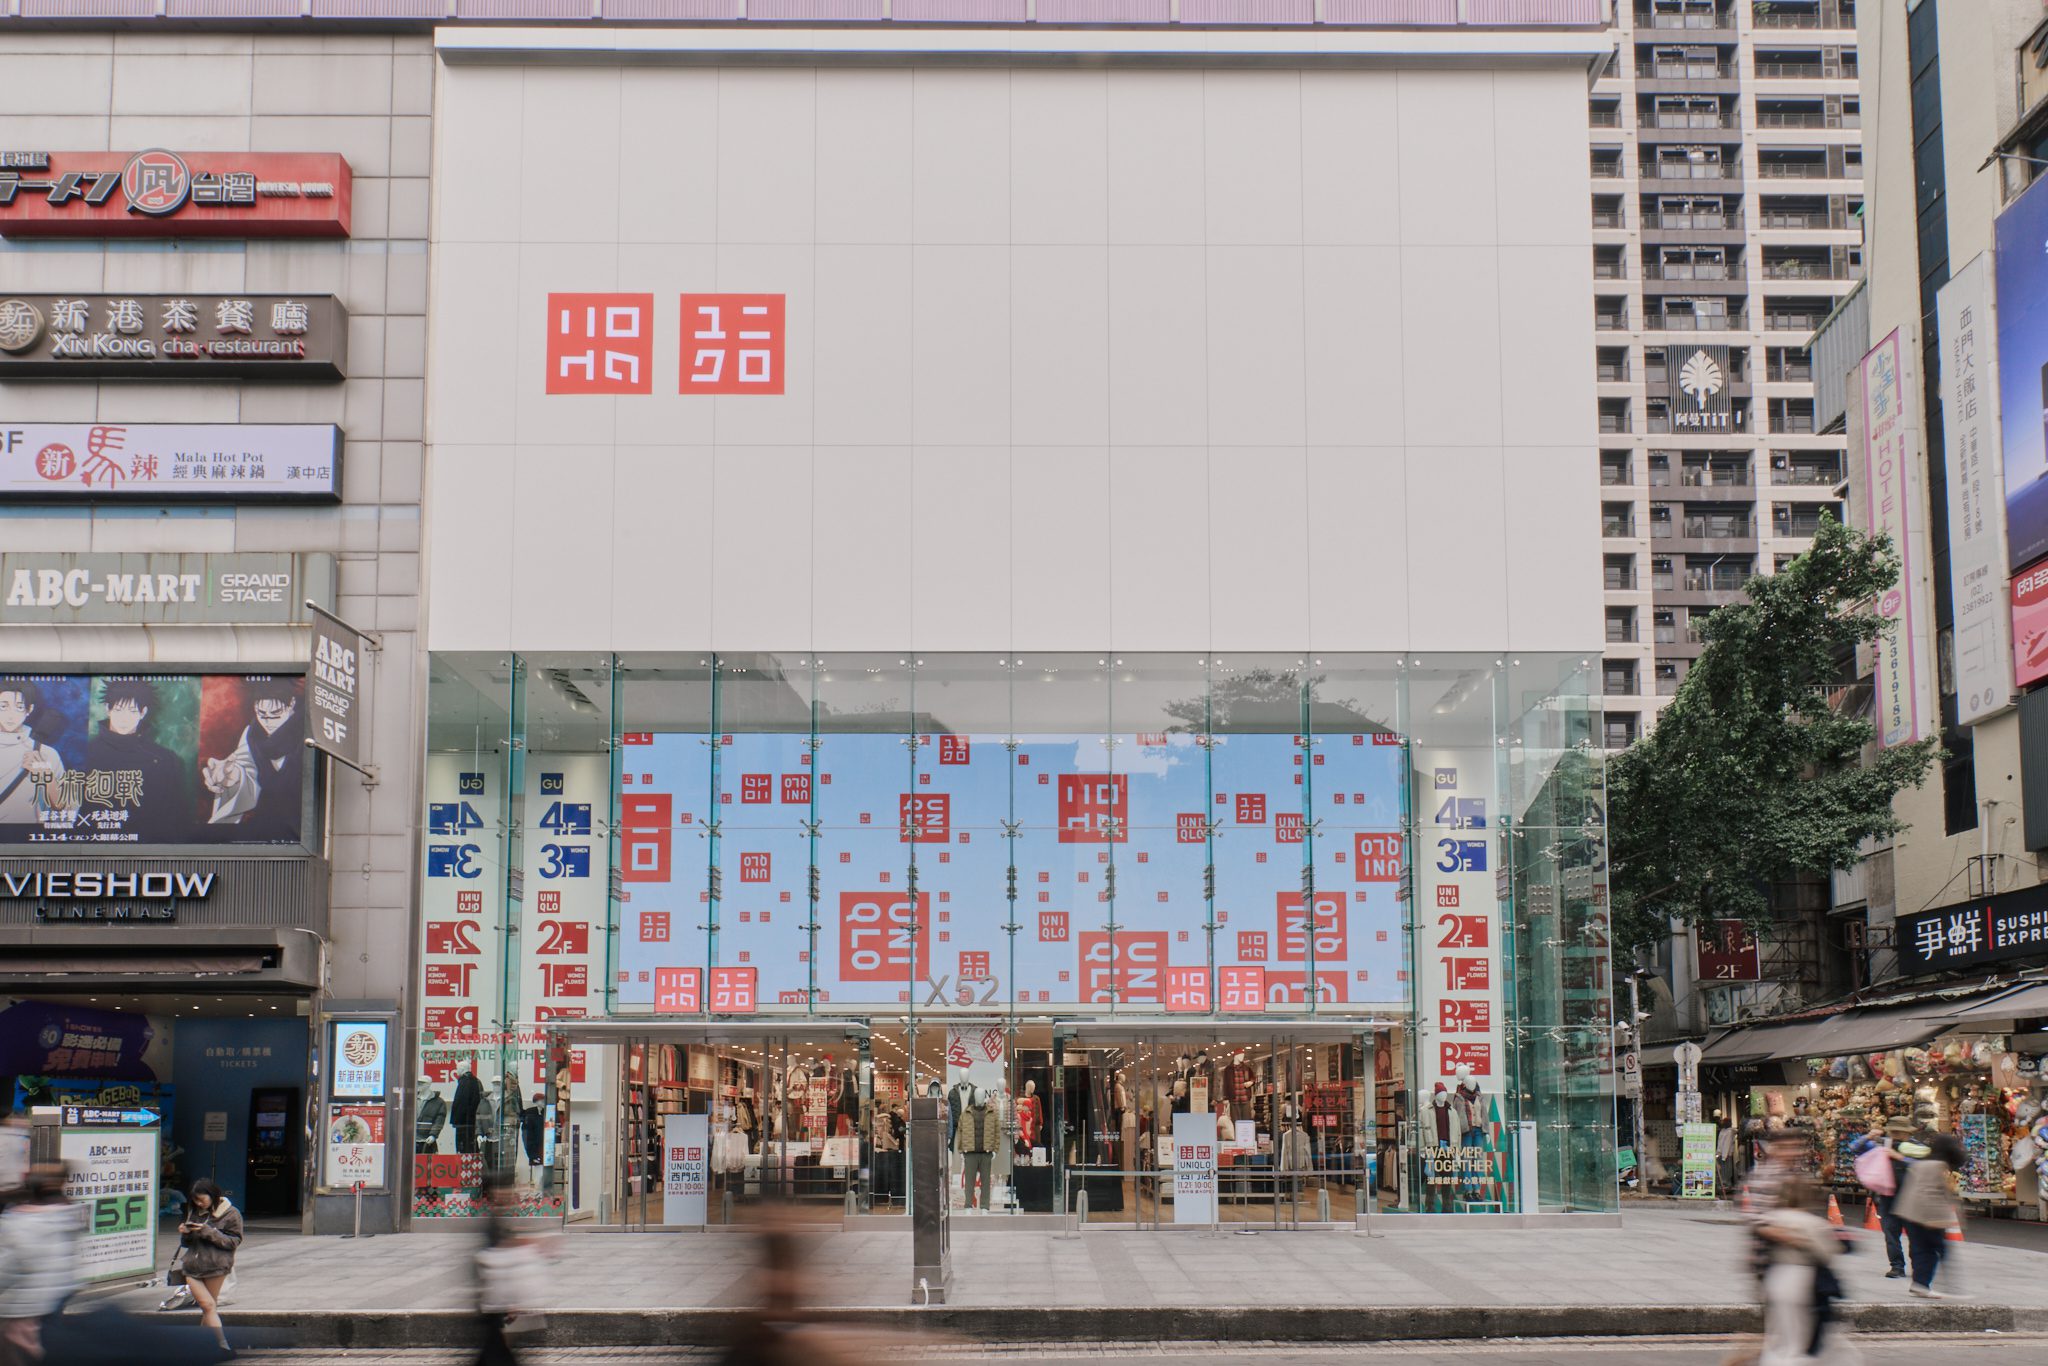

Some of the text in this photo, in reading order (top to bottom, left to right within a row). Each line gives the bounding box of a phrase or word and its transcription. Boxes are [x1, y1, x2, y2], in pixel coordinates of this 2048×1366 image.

[51, 300, 308, 334] 新港茶餐廳
[209, 338, 302, 356] restaurant
[174, 452, 264, 463] Mala Hot Pot
[172, 464, 331, 480] 經典麻辣鍋 漢中店
[1878, 440, 1894, 533] HOTEL
[7, 569, 201, 607] ABC-MART
[220, 574, 290, 588] GRAND
[220, 588, 283, 602] STAGE
[1884, 596, 1900, 613] 9F
[315, 634, 355, 675] ABC
[315, 659, 355, 694] MART
[1889, 635, 1901, 728] 23619183
[314, 685, 350, 709] GRAND
[314, 695, 346, 718] STAGE
[323, 716, 347, 743] 5F
[542, 779, 562, 790] GU
[1436, 773, 1456, 784] GU
[539, 801, 577, 835] 4F
[1435, 796, 1472, 830] 4F
[538, 844, 575, 879] 3F
[1436, 838, 1472, 873] 3F
[2, 873, 216, 897] VIESHOW
[1439, 887, 1456, 895] UNI
[540, 893, 557, 901] UNI
[1439, 896, 1458, 905] QLO
[35, 908, 173, 919] CINEMAS
[540, 903, 558, 911] QLO
[1042, 915, 1064, 925] UNI
[1997, 910, 2048, 931] SUSHI
[536, 920, 572, 954] 2F
[1042, 928, 1066, 940] QLO
[1437, 913, 1473, 948] 2F
[1915, 910, 1983, 960] 爭鮮
[1440, 957, 1466, 990] 1F
[1716, 964, 1743, 979] 2F
[538, 963, 564, 997] 1F
[924, 974, 1000, 1007] X52
[439, 1033, 513, 1044] CELEBRATE
[421, 1049, 534, 1060] CELEBRATE WITH
[221, 1060, 258, 1068] TICKETS
[83, 1110, 120, 1118] ABC-MART
[89, 1145, 131, 1156] ABC-MART
[1425, 1146, 1483, 1158] WARMER
[433, 1163, 460, 1179] GU
[671, 1162, 701, 1170] UNIQLO
[1181, 1161, 1211, 1169] UNIQLO
[1425, 1160, 1493, 1172] TOGETHER
[66, 1171, 117, 1183] UNIQLO
[671, 1172, 701, 1181] 西門店
[95, 1196, 145, 1227] 5F
